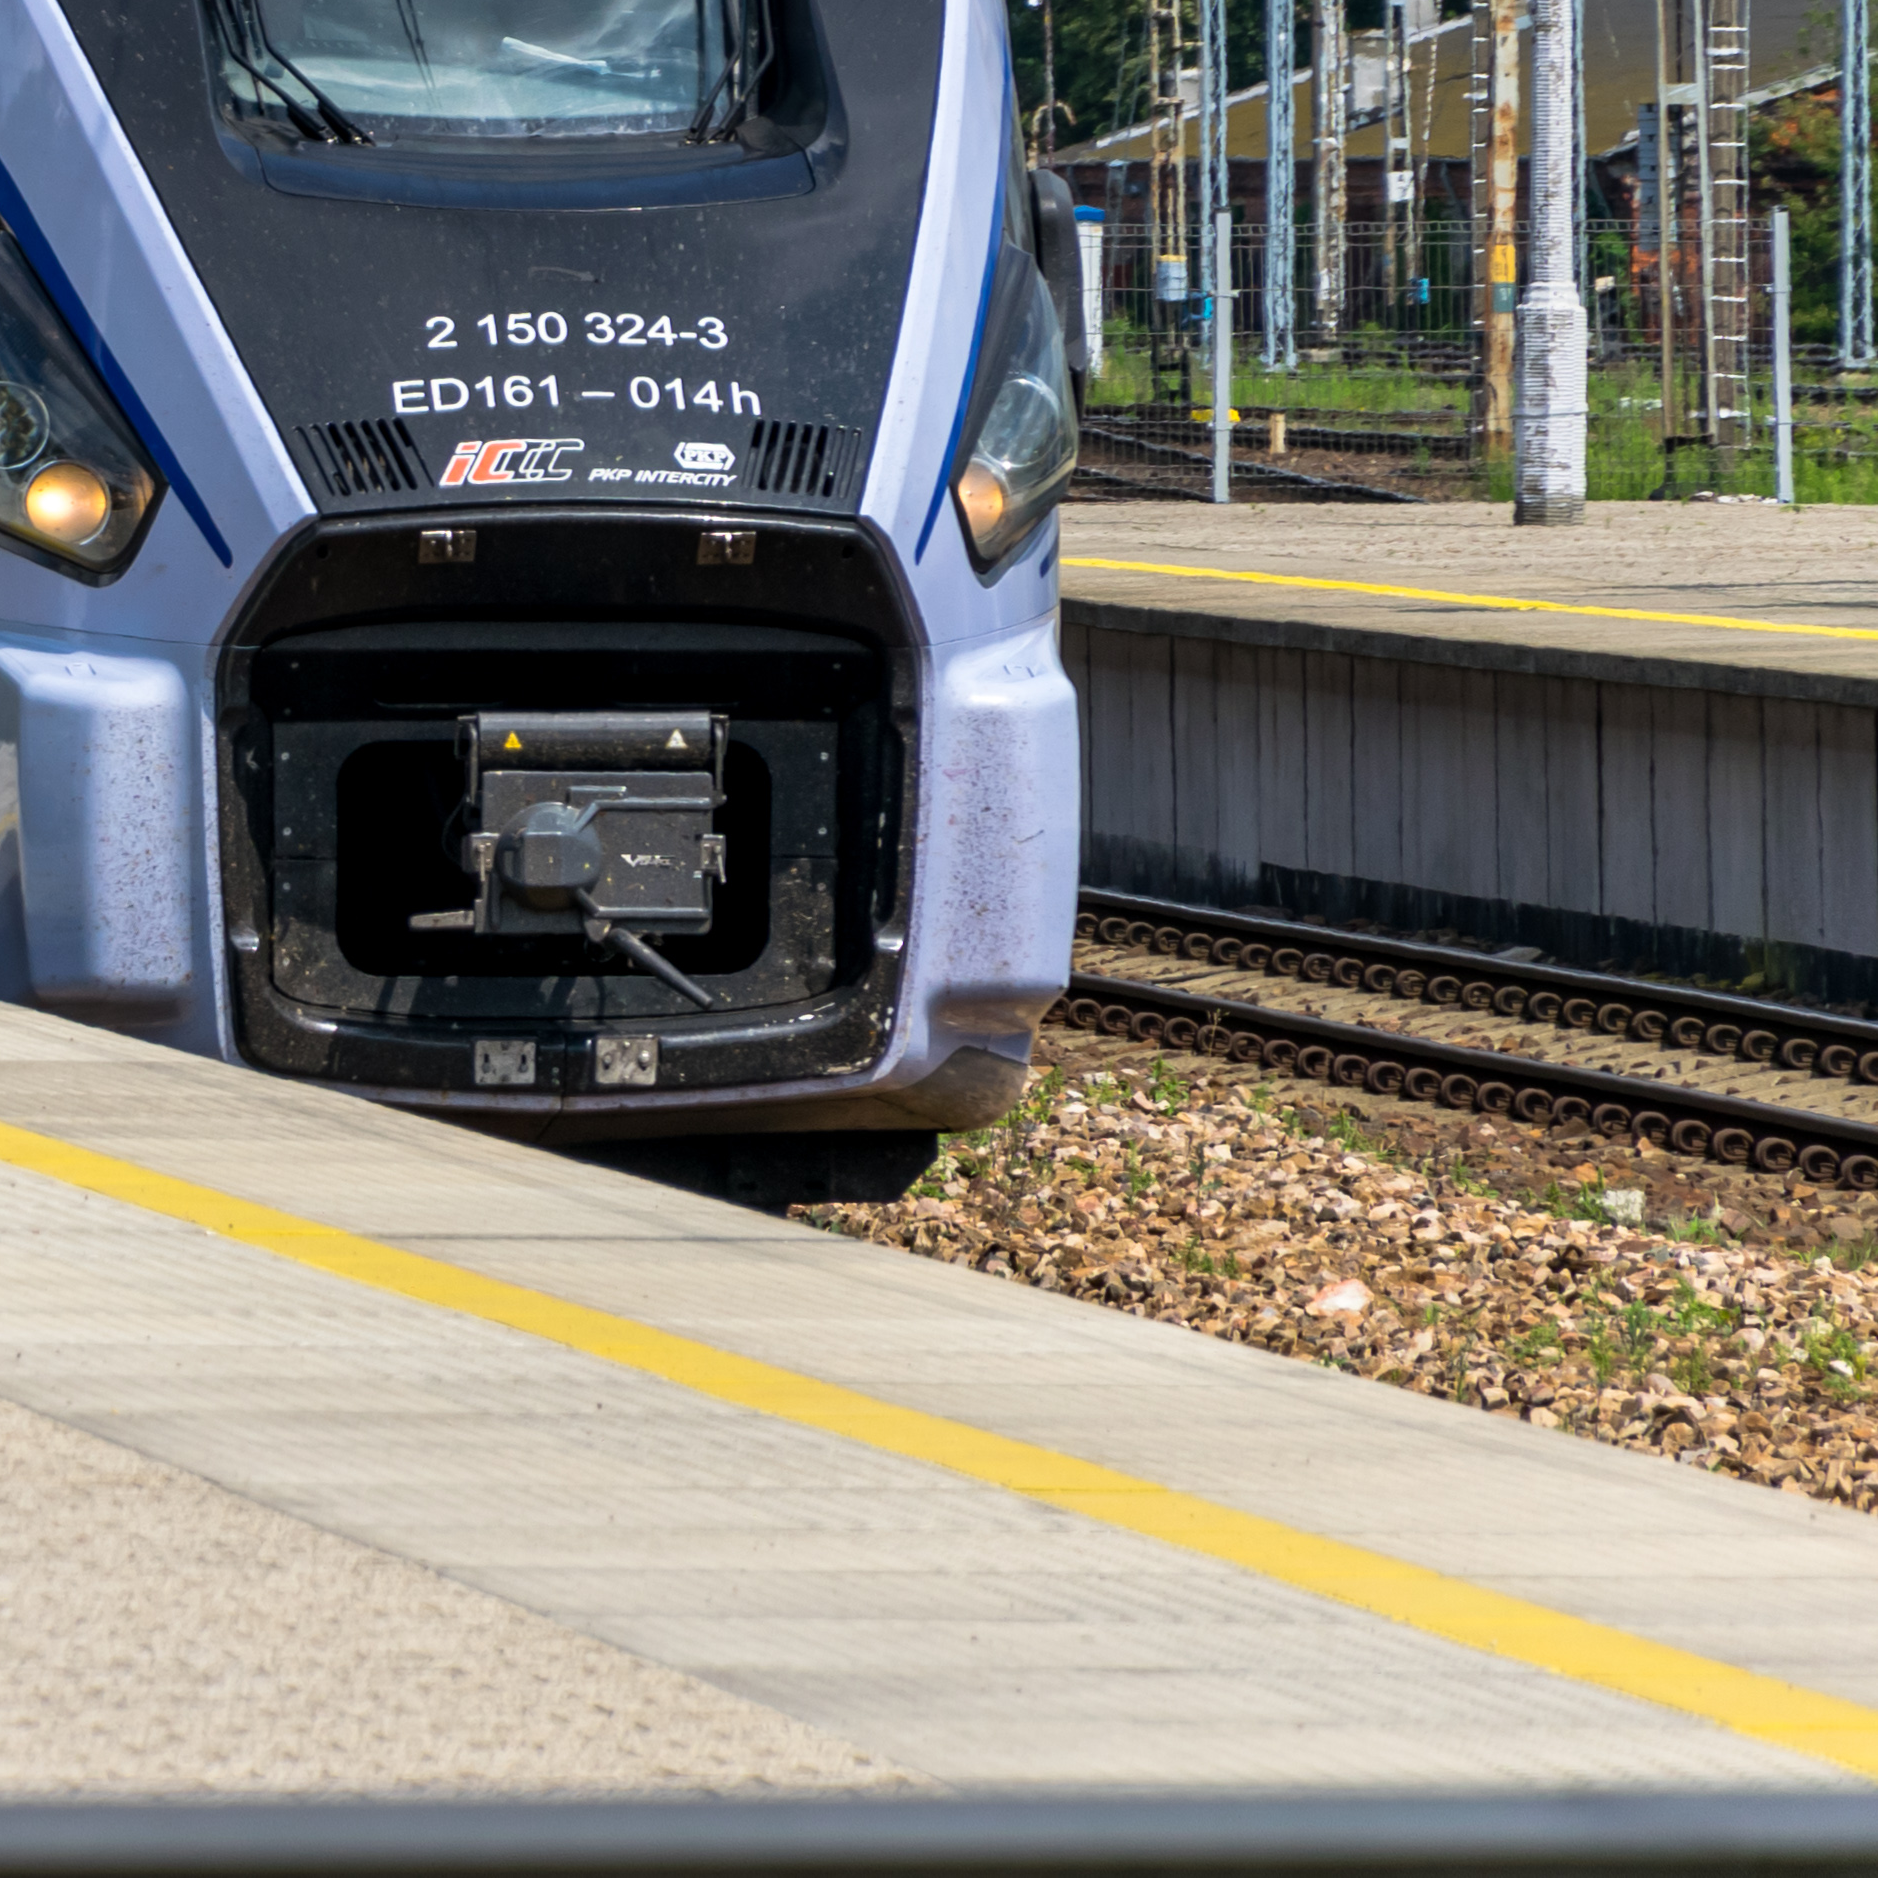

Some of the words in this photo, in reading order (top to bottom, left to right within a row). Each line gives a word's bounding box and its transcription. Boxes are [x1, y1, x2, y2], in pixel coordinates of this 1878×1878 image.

[426, 316, 458, 349] 2
[476, 312, 568, 346] 150
[584, 312, 729, 350] 324-3
[392, 374, 560, 414] ED161
[588, 468, 632, 482] PKP
[634, 469, 738, 488] INTERCITY
